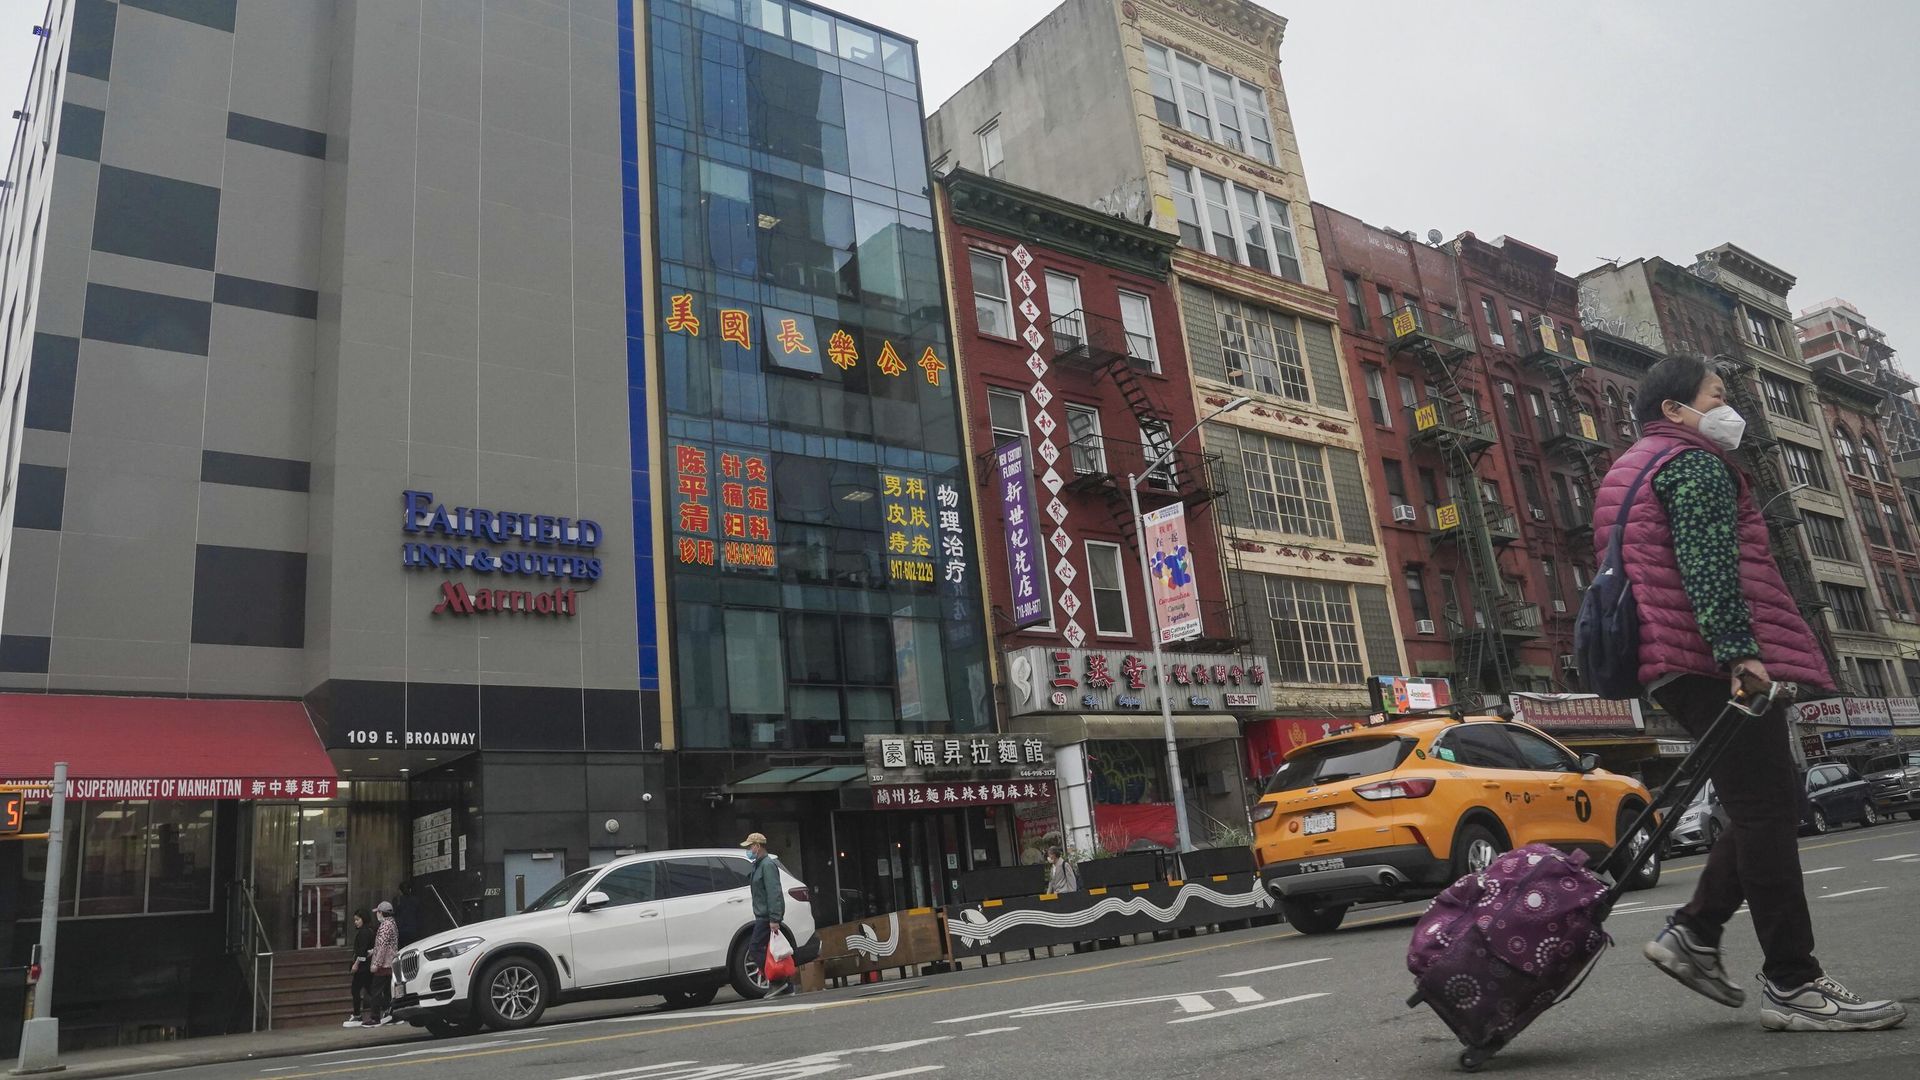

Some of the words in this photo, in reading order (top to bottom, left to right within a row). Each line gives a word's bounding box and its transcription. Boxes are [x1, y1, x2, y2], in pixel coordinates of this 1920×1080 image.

[1397, 315, 1413, 333] 福
[666, 293, 947, 387] 美國長樂公會
[1418, 407, 1435, 426] 州
[721, 453, 767, 482] 针灸
[721, 482, 769, 511] 痛症
[883, 475, 926, 501] 男科
[402, 489, 604, 549] FAIRFIELD
[723, 511, 771, 541] 妇科
[887, 503, 930, 528] 皮肤
[1440, 508, 1456, 526] 超
[889, 531, 932, 556] 痔疮
[936, 483, 967, 584] 物理治疗
[403, 542, 468, 570] INN
[471, 547, 497, 573] &
[500, 550, 604, 581] SUITES
[431, 579, 577, 617] Marriott
[1167, 611, 1191, 623] Together
[1171, 628, 1195, 639] Foundation
[1053, 693, 1066, 705] 105
[1820, 702, 1841, 716] Bus
[347, 730, 378, 744] 109
[386, 731, 398, 744] E.
[406, 732, 476, 745] BROADWAY
[77, 779, 161, 799] SUPERMARKET
[161, 779, 175, 797] OF
[177, 778, 242, 797] MANHATTAN
[251, 779, 331, 796] 新中華超市
[7, 800, 19, 826] 5
[1578, 797, 1587, 818] T
